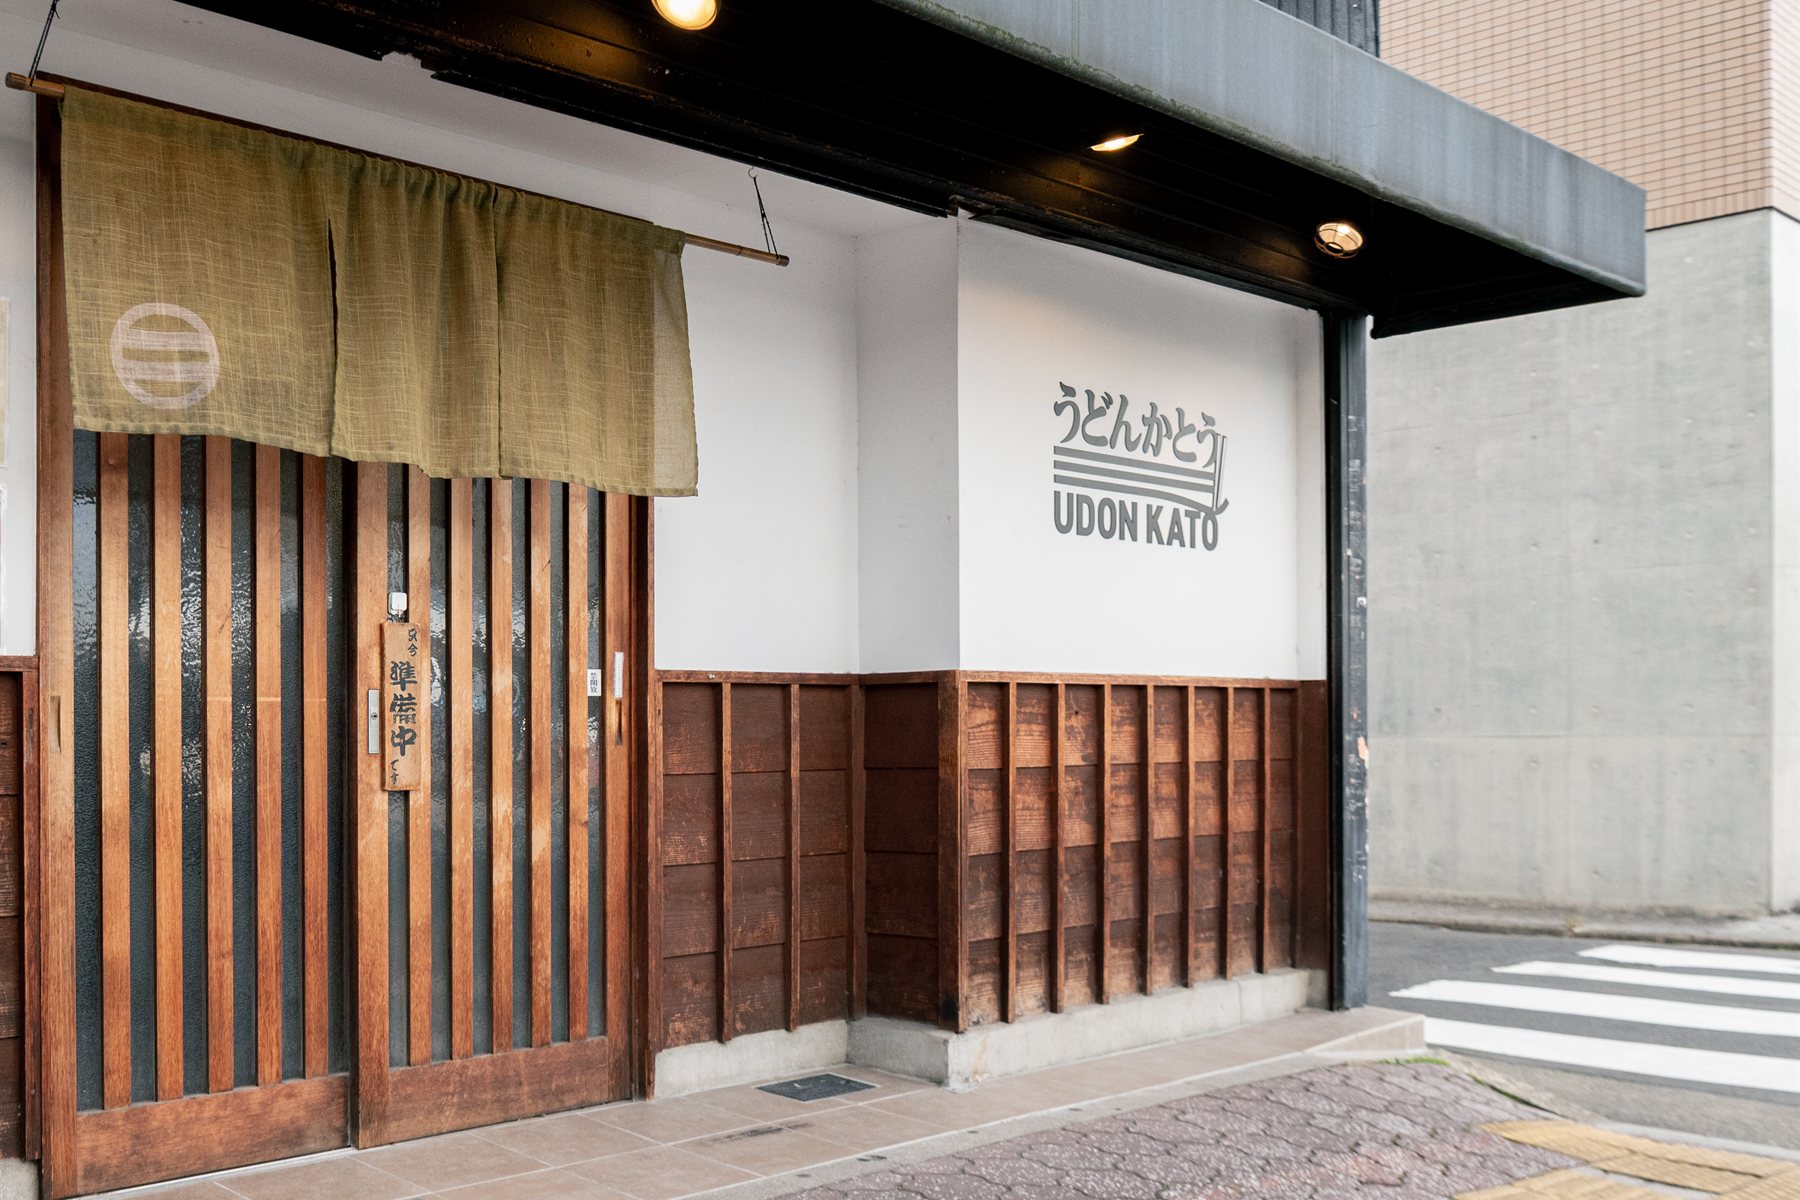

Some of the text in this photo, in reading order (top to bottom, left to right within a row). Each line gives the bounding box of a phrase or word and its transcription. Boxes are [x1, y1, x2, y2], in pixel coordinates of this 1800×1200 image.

[1054, 381, 1218, 468] うどんかとう
[1054, 490, 1219, 552] UDON KATO
[389, 661, 418, 757] 準備中
